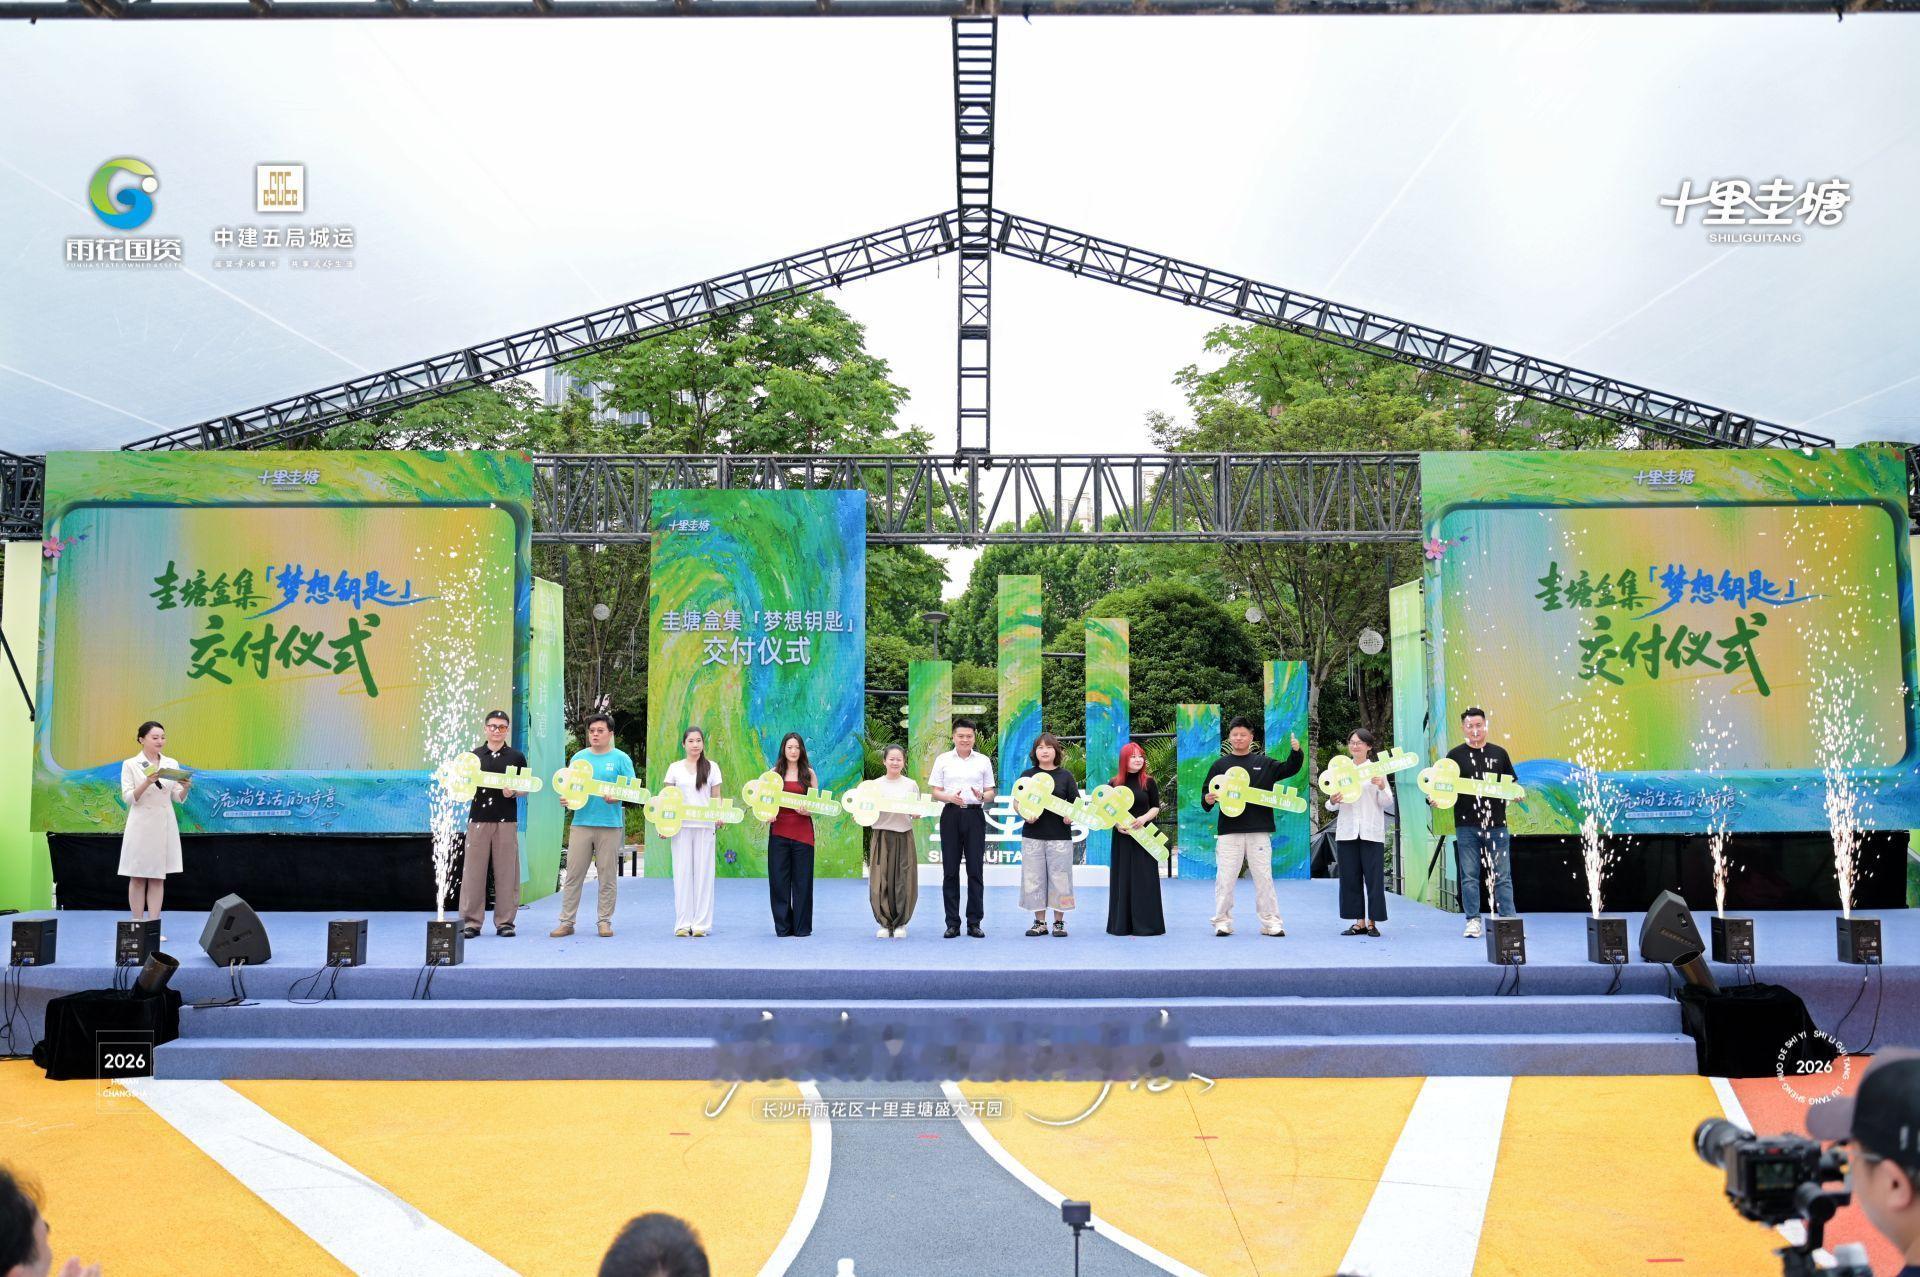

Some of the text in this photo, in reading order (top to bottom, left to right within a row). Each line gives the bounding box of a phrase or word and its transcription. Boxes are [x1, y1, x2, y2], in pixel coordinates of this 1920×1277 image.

[257, 469, 320, 485] 十里圭塘
[1633, 469, 1695, 485] 十里圭塘
[668, 519, 711, 532] 十里圭塘
[661, 609, 855, 632] 圭塘盒集「梦想钥匙」
[186, 613, 380, 698] 交付仪式
[702, 636, 811, 665] 交付仪式
[1577, 612, 1771, 697] 交付仪式
